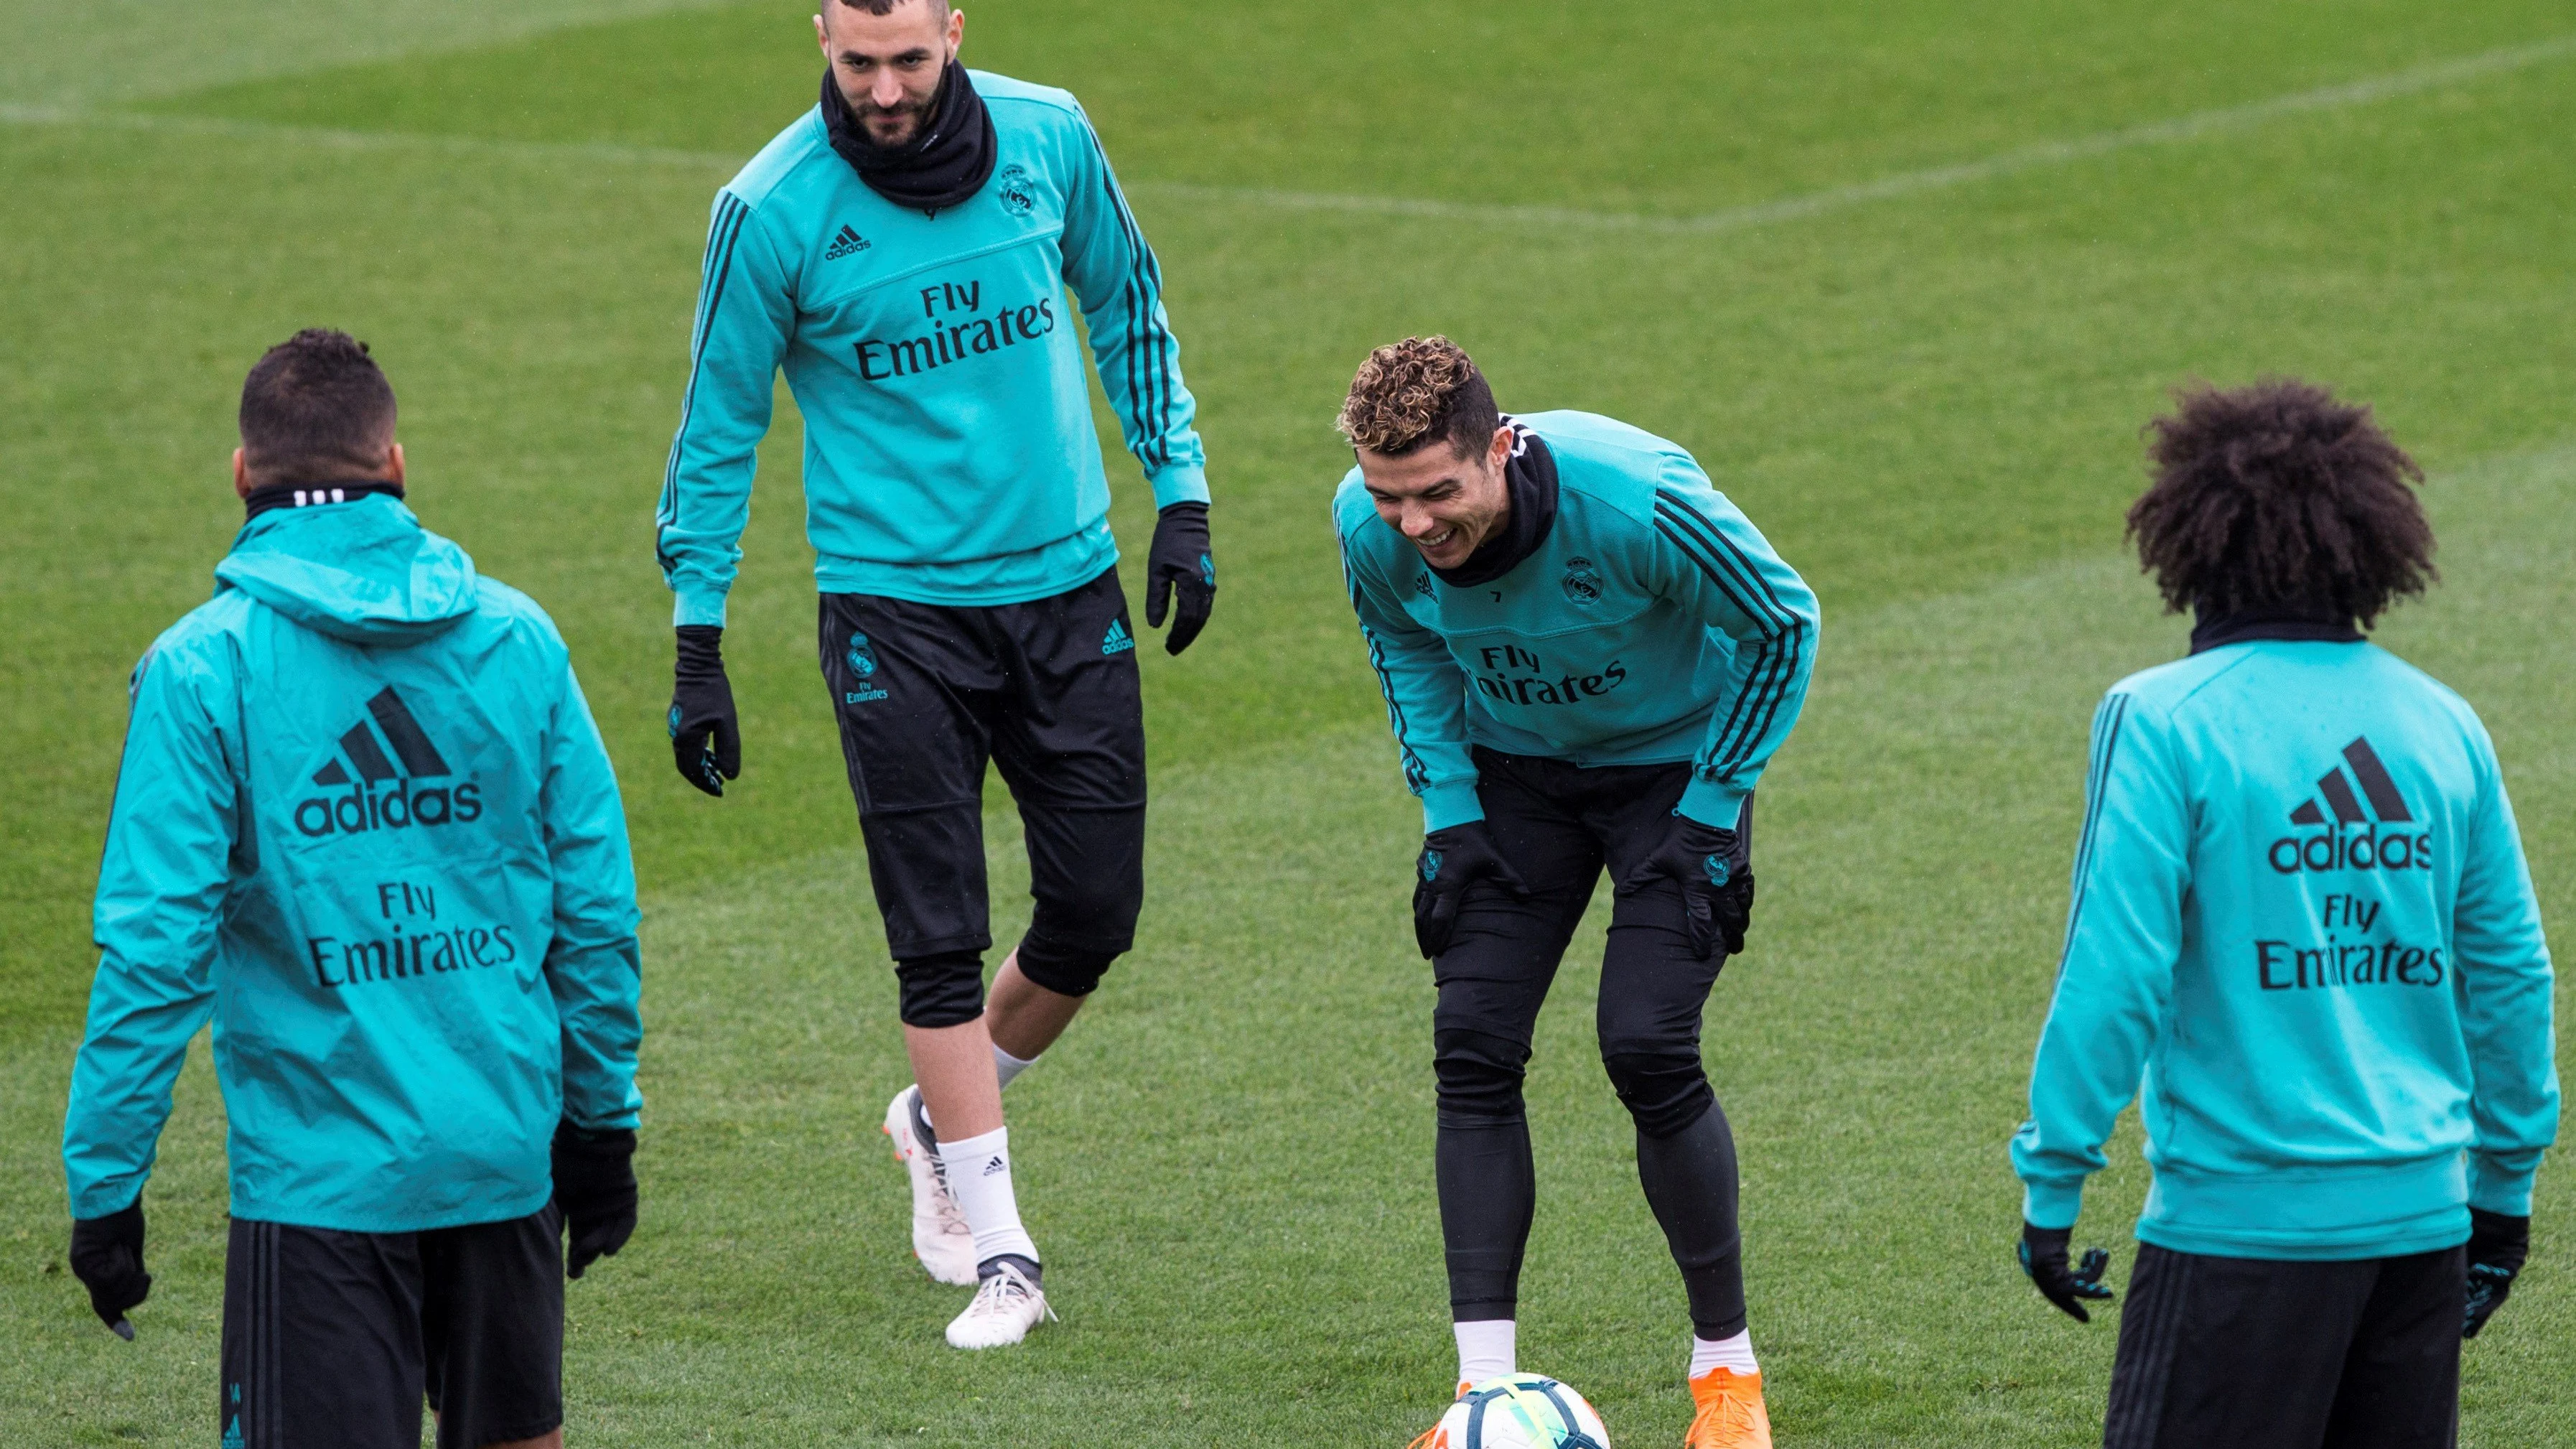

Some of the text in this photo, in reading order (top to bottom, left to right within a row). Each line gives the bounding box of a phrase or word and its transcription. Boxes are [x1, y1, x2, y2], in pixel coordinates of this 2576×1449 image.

[826, 240, 871, 261] adidas
[920, 280, 980, 317] Fly
[853, 297, 1054, 381] Emirates
[1490, 591, 1502, 602] 7
[1102, 638, 1134, 655] adidas
[1480, 644, 1541, 674] Fly
[846, 689, 889, 704] Emirates
[859, 681, 872, 691] Fly
[1476, 660, 1626, 705] mirates
[294, 778, 482, 837] adidas
[2268, 823, 2432, 875] adidas
[377, 881, 437, 920] Fly
[2323, 893, 2381, 933] Fly
[307, 923, 515, 989] Emirates
[2254, 934, 2445, 990] Emirates
